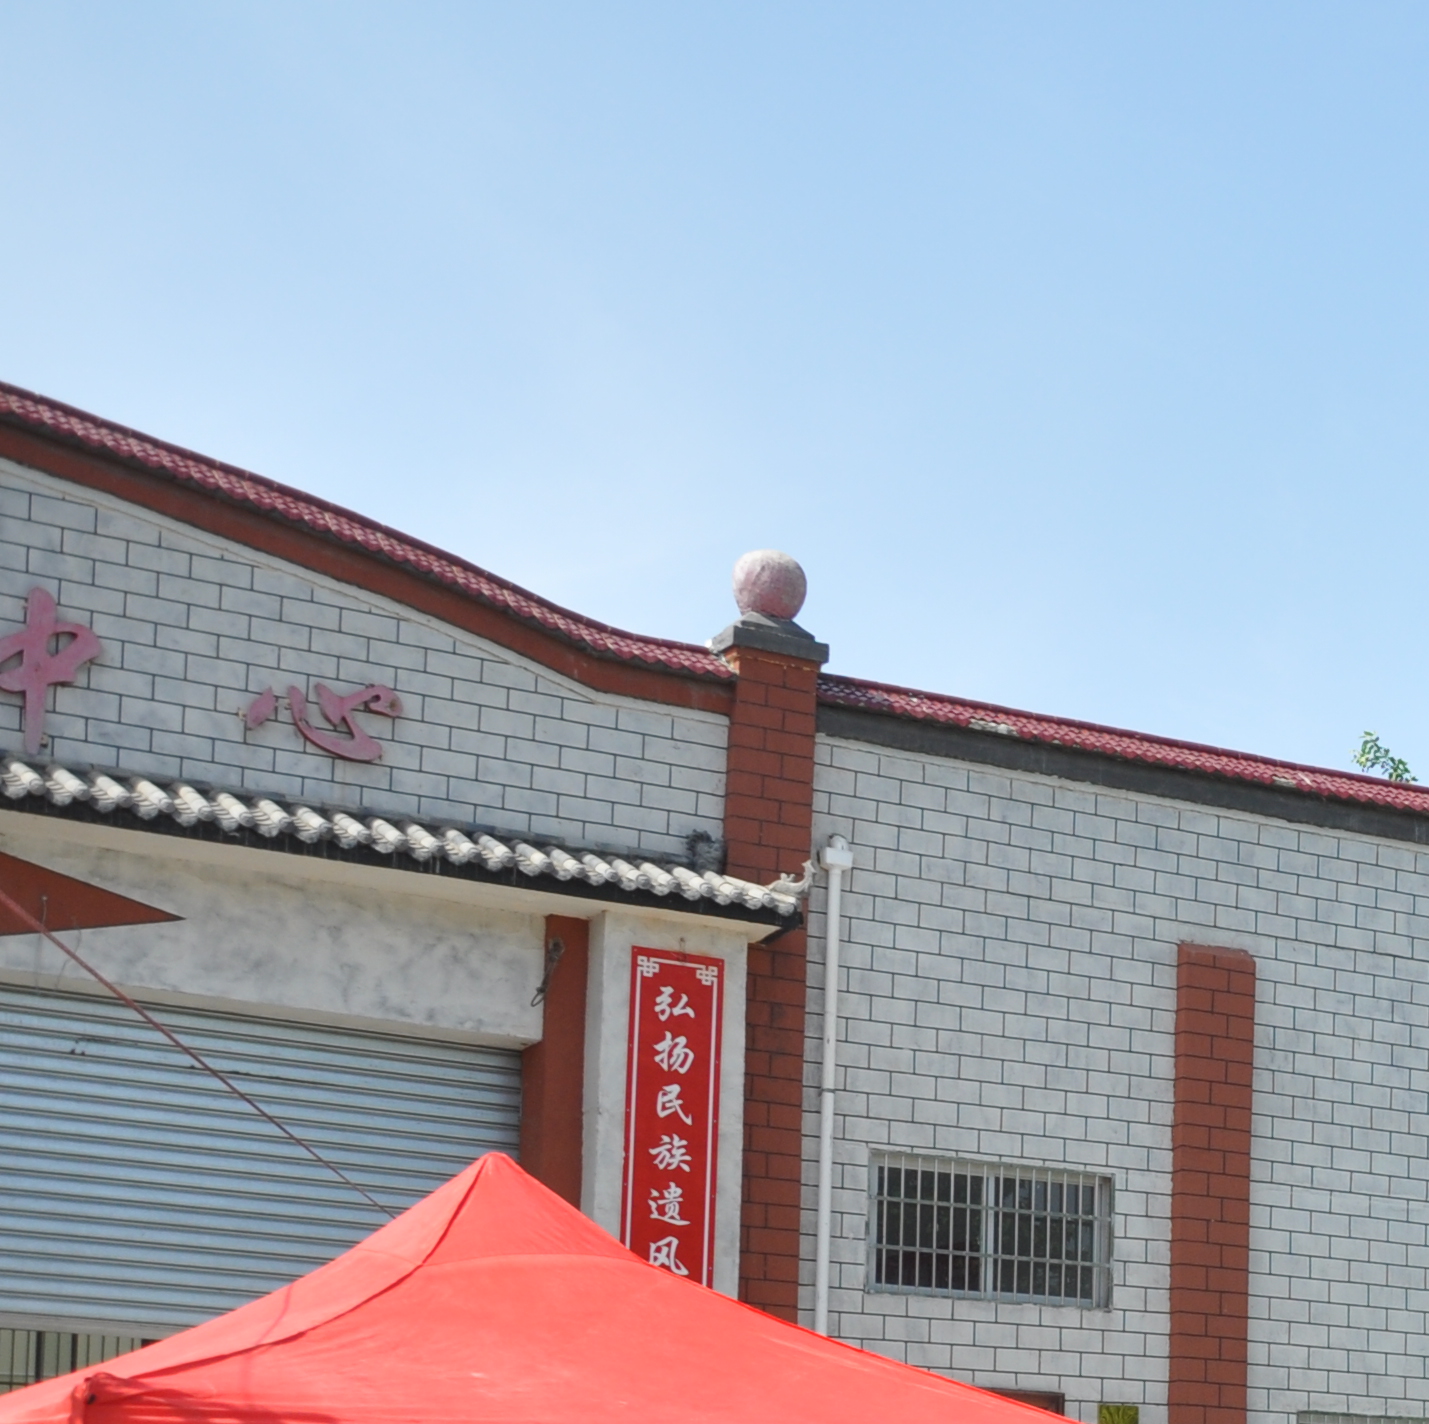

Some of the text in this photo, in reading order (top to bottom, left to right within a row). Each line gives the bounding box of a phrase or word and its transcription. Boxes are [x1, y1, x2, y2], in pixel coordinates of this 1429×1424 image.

[649, 985, 696, 1276] 弘扬民族遗风
